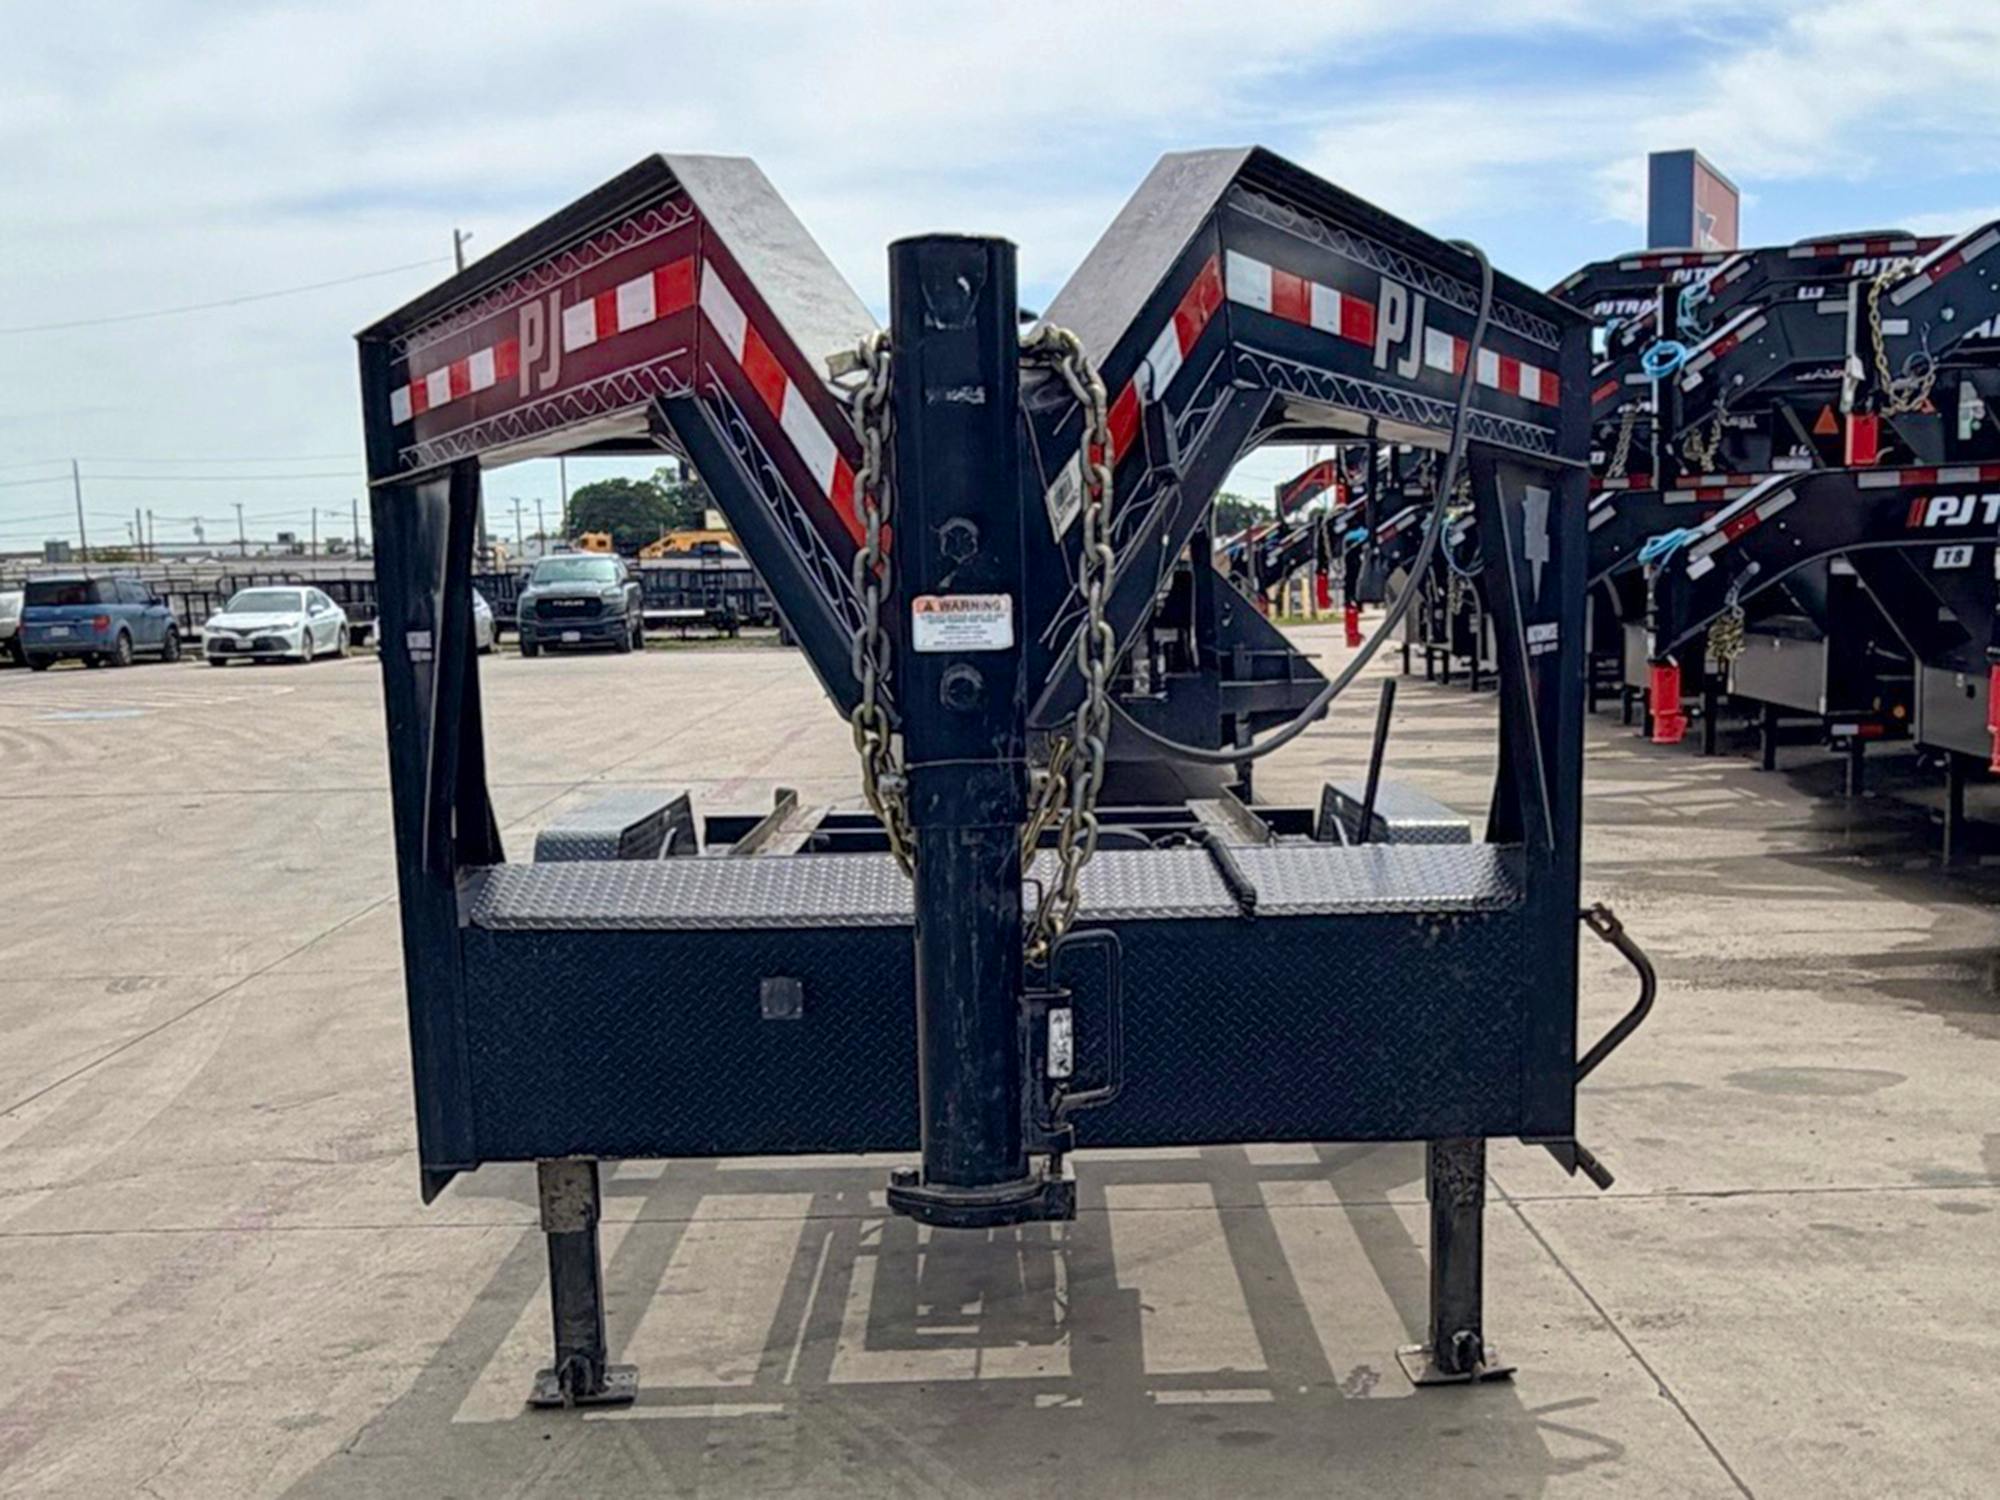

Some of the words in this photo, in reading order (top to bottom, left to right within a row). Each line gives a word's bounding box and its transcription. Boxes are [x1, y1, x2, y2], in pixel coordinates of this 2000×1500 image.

[519, 290, 563, 397] PJ
[1372, 276, 1426, 379] PJ
[939, 600, 1001, 612] WARNING
